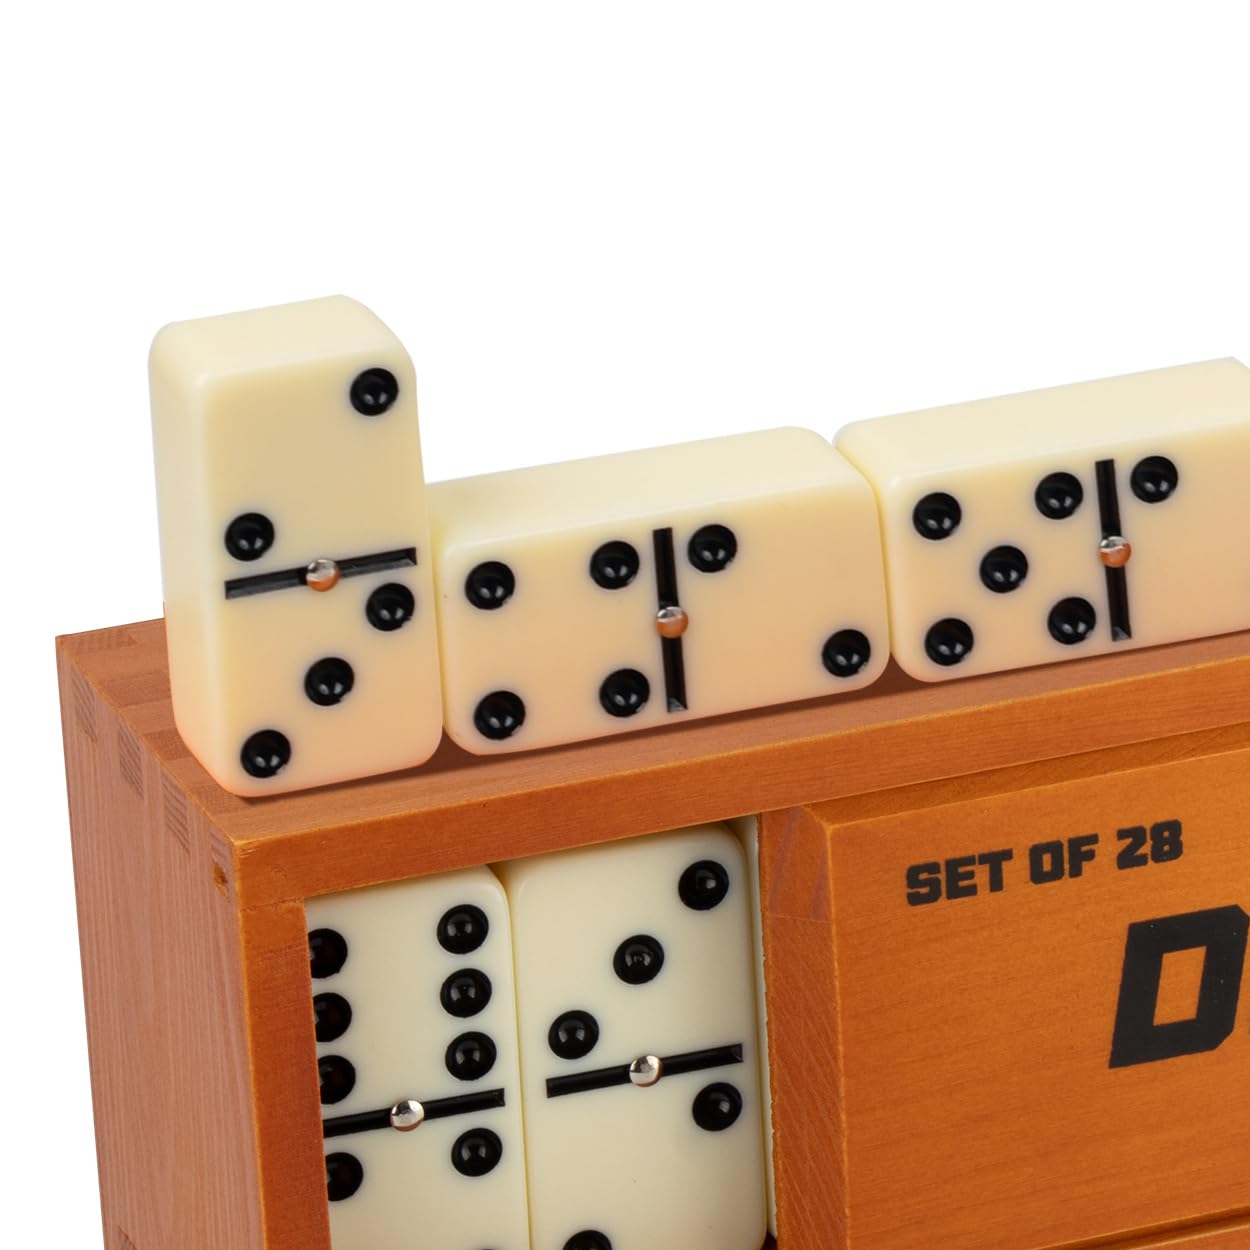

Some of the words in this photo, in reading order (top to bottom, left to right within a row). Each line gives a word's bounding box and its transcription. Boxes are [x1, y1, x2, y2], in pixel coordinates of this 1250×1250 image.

[905, 848, 1014, 907] SET
[1028, 833, 1100, 886] OF
[1116, 819, 1183, 871] 28
